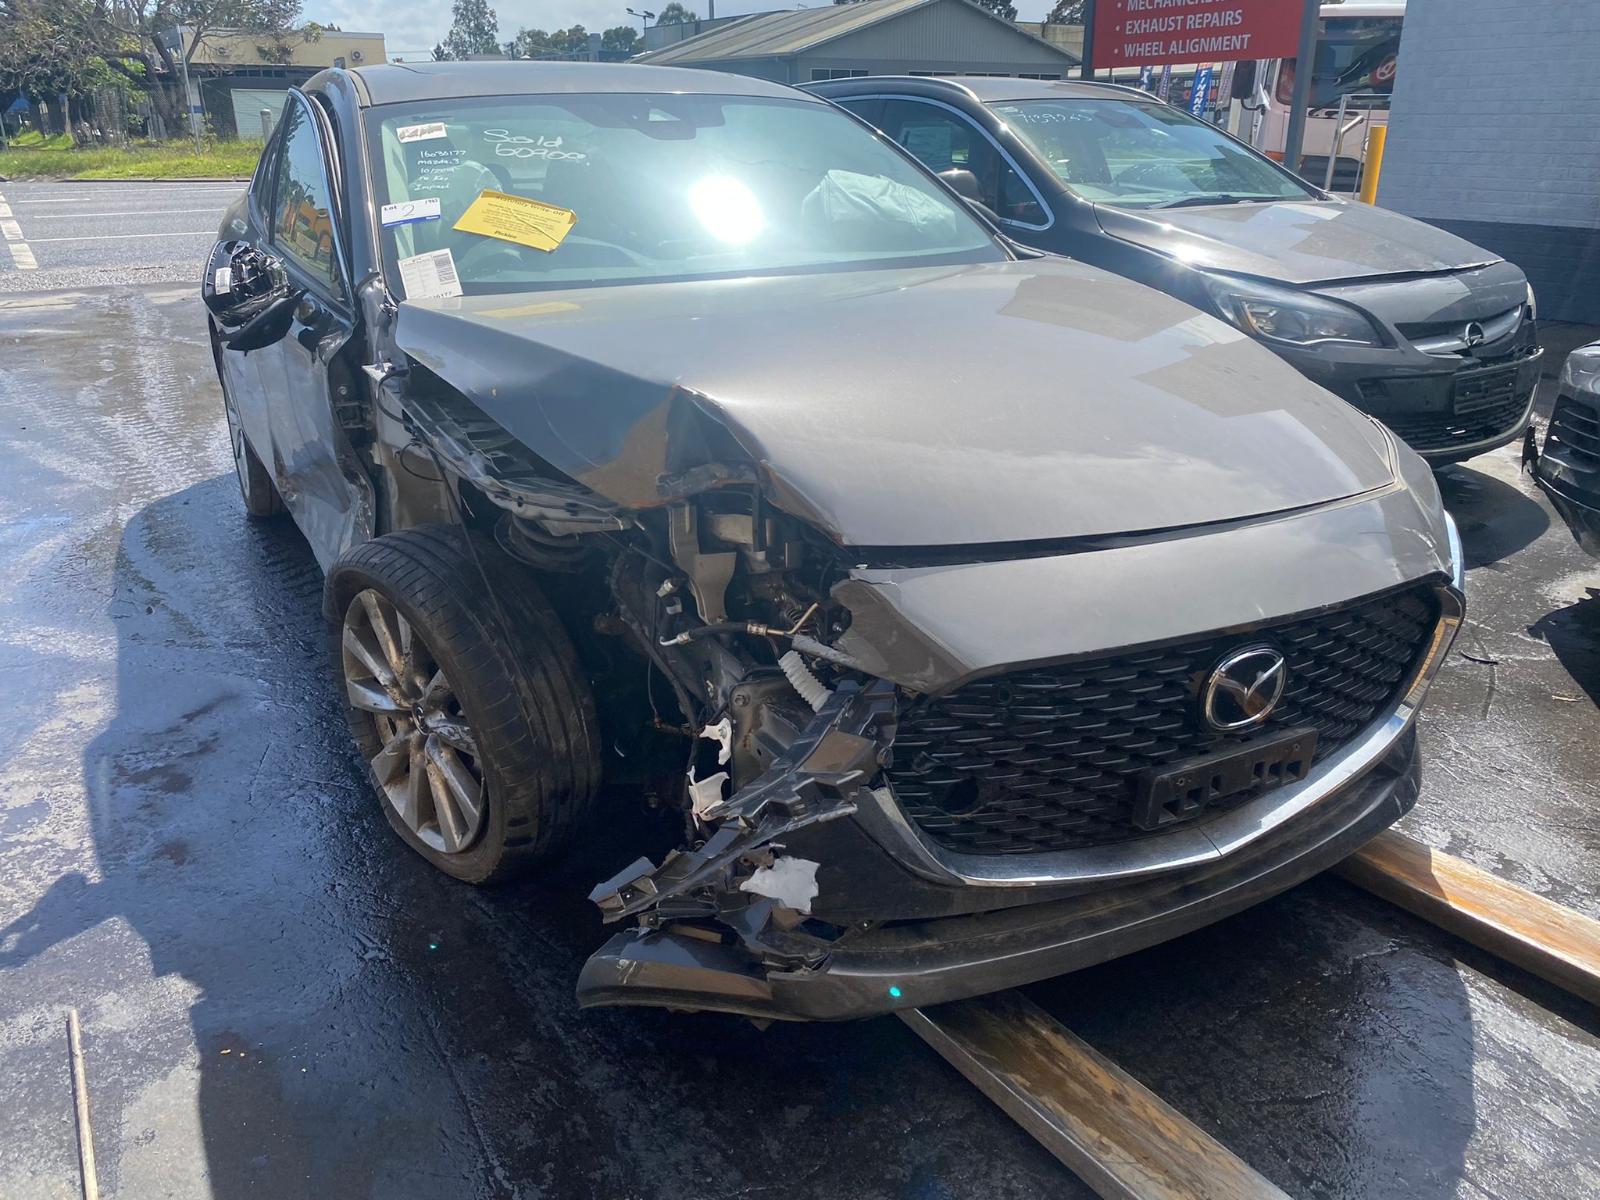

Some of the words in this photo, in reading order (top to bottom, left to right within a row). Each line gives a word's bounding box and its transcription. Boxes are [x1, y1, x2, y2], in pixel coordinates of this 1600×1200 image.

[1125, 16, 1184, 35] EXHAUST
[1186, 9, 1243, 30] REPAIRS
[1124, 42, 1166, 58] WHEEL
[1168, 34, 1252, 55] ALIGNMENT
[483, 128, 563, 148] Sold
